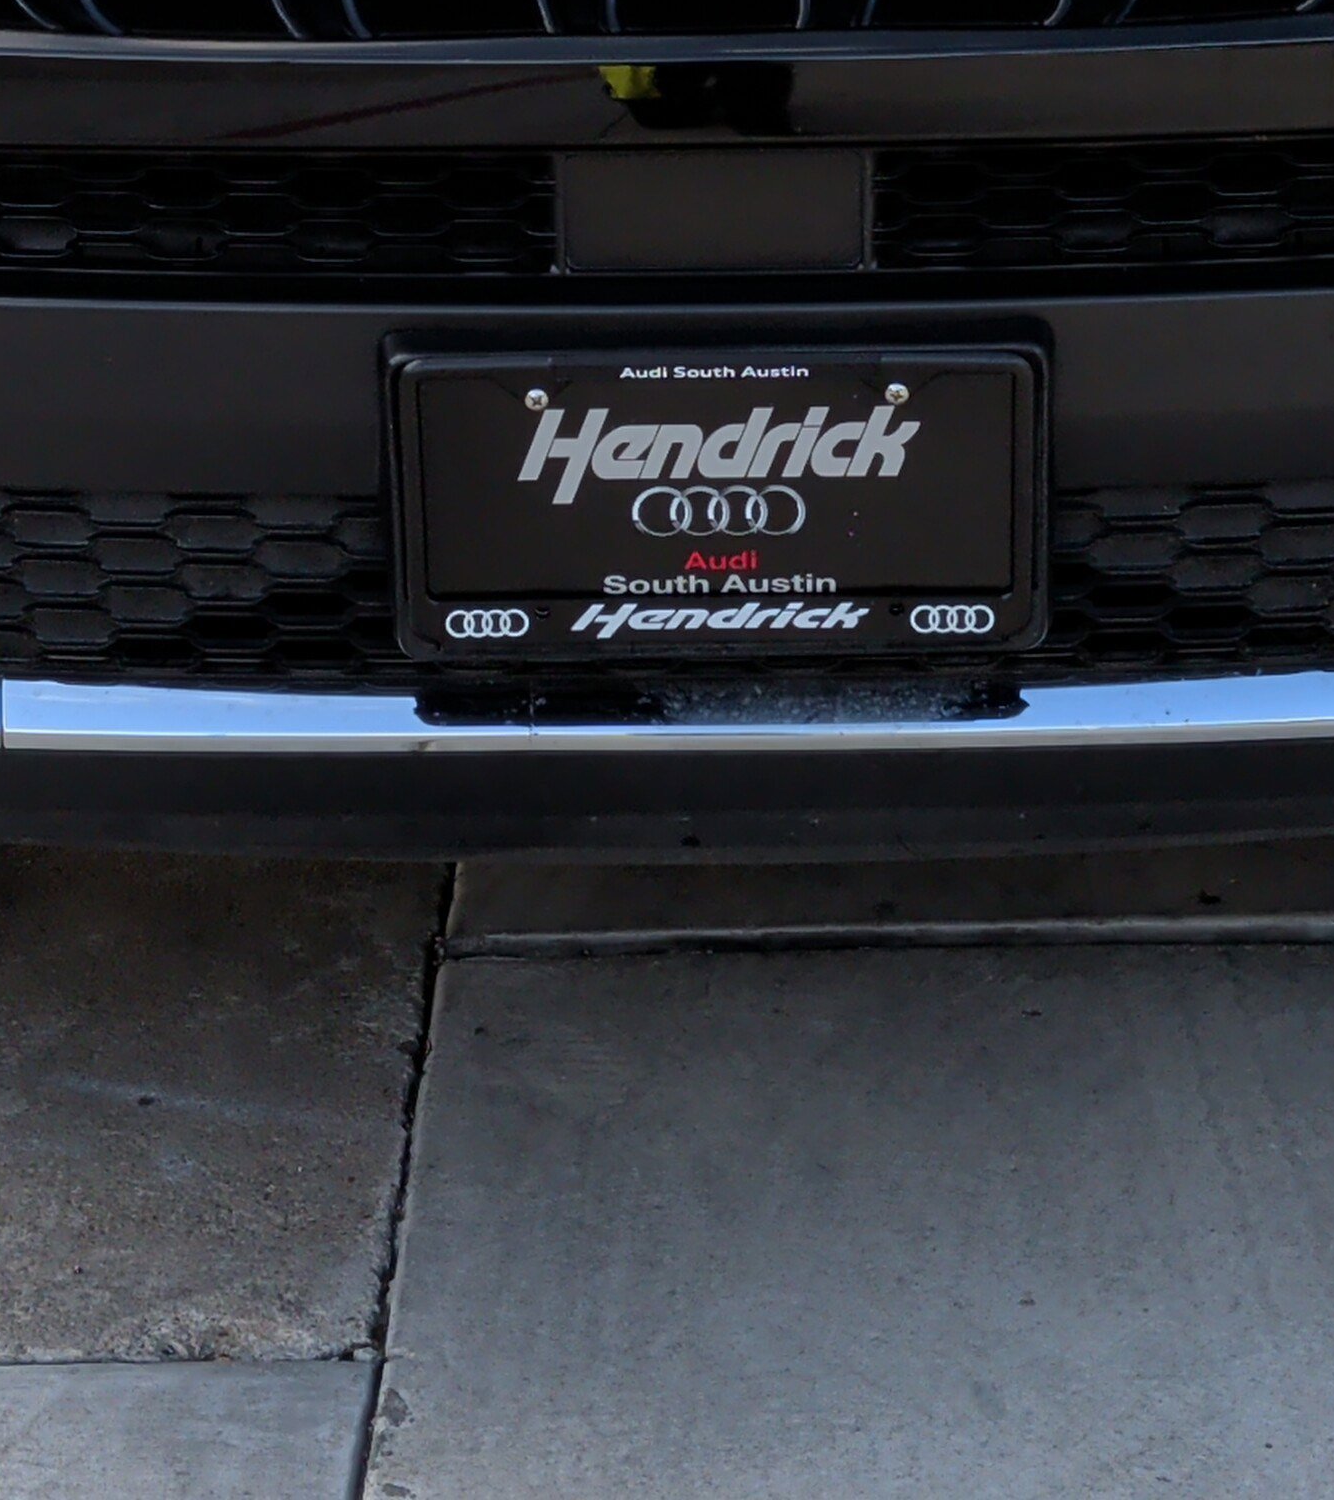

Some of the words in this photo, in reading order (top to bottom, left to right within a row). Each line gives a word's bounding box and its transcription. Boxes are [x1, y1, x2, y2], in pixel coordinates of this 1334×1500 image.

[619, 367, 668, 379] Audi
[673, 366, 736, 379] South
[740, 365, 809, 378] Austin
[517, 405, 921, 504] Hendrick
[684, 550, 759, 571] Audi
[603, 574, 710, 595] South
[720, 573, 837, 594] Austin
[571, 602, 869, 639] Hendrick
